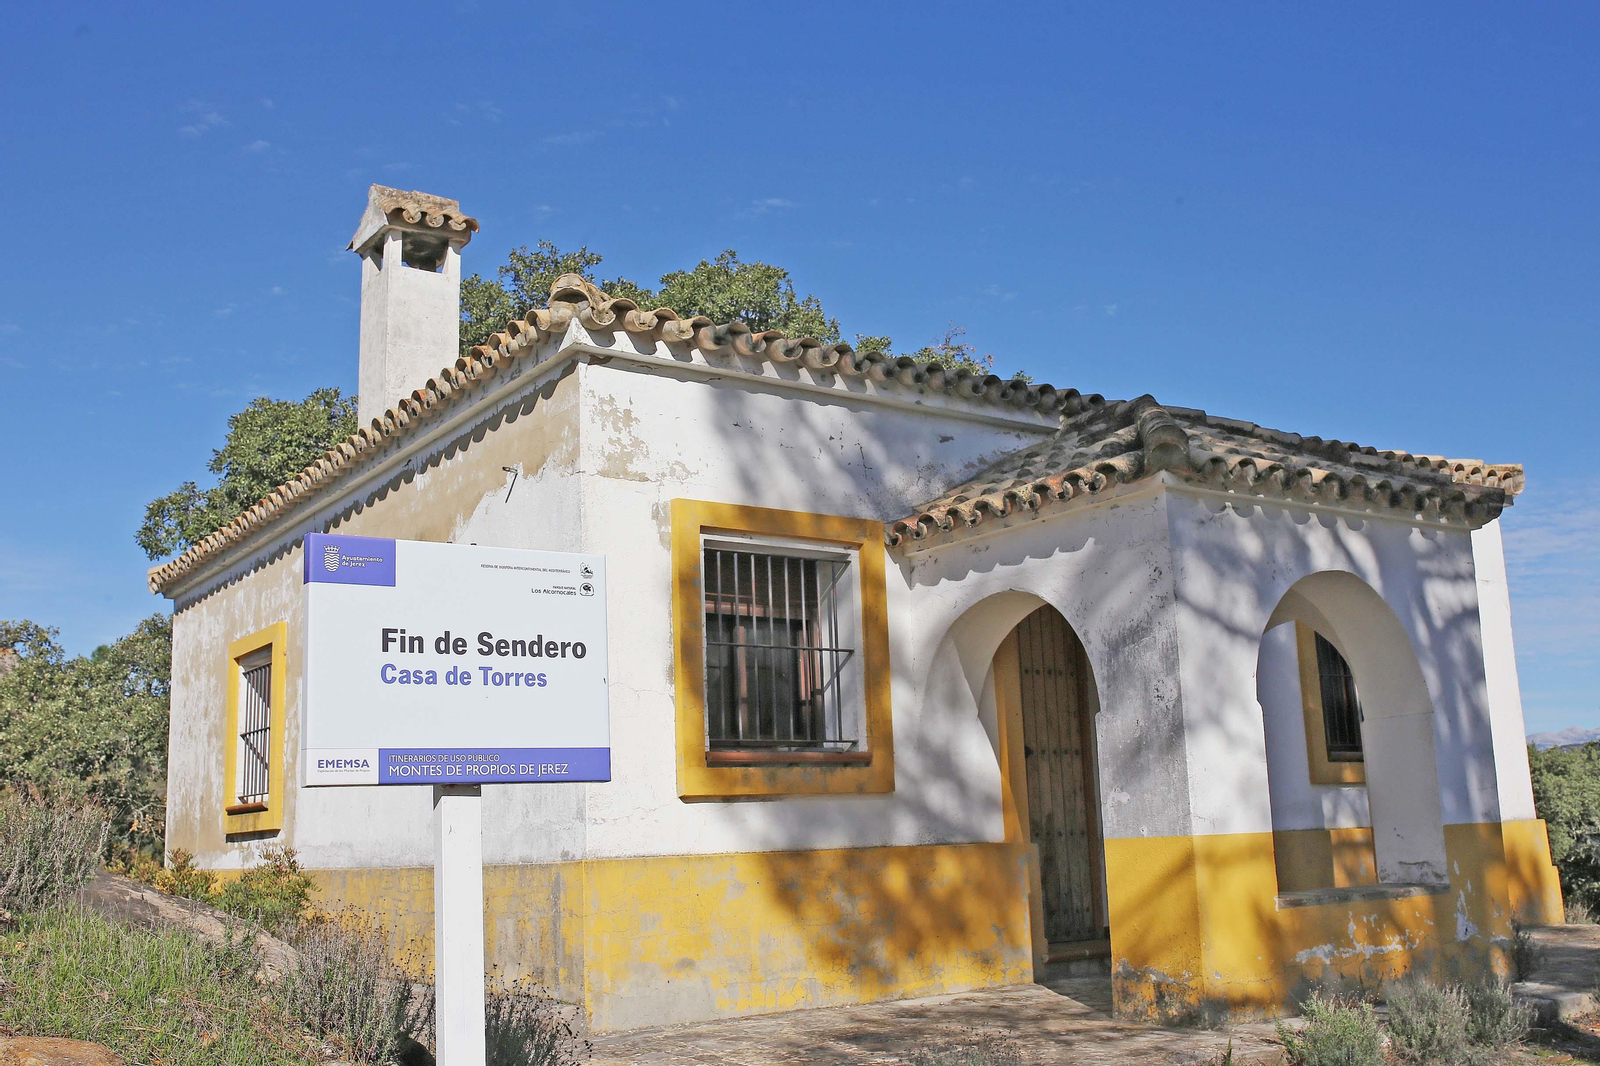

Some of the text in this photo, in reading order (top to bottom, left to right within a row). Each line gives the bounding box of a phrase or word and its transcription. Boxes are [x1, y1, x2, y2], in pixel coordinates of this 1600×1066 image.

[382, 628, 587, 659] Fin de Sendero
[380, 663, 548, 687] Casa de Torres
[318, 759, 369, 768] EMEMSA
[388, 754, 436, 763] ITINERARIOS
[468, 753, 500, 762] PÚBLICO
[389, 763, 569, 777] MONTES DE PROPIOS DE JEREZ
